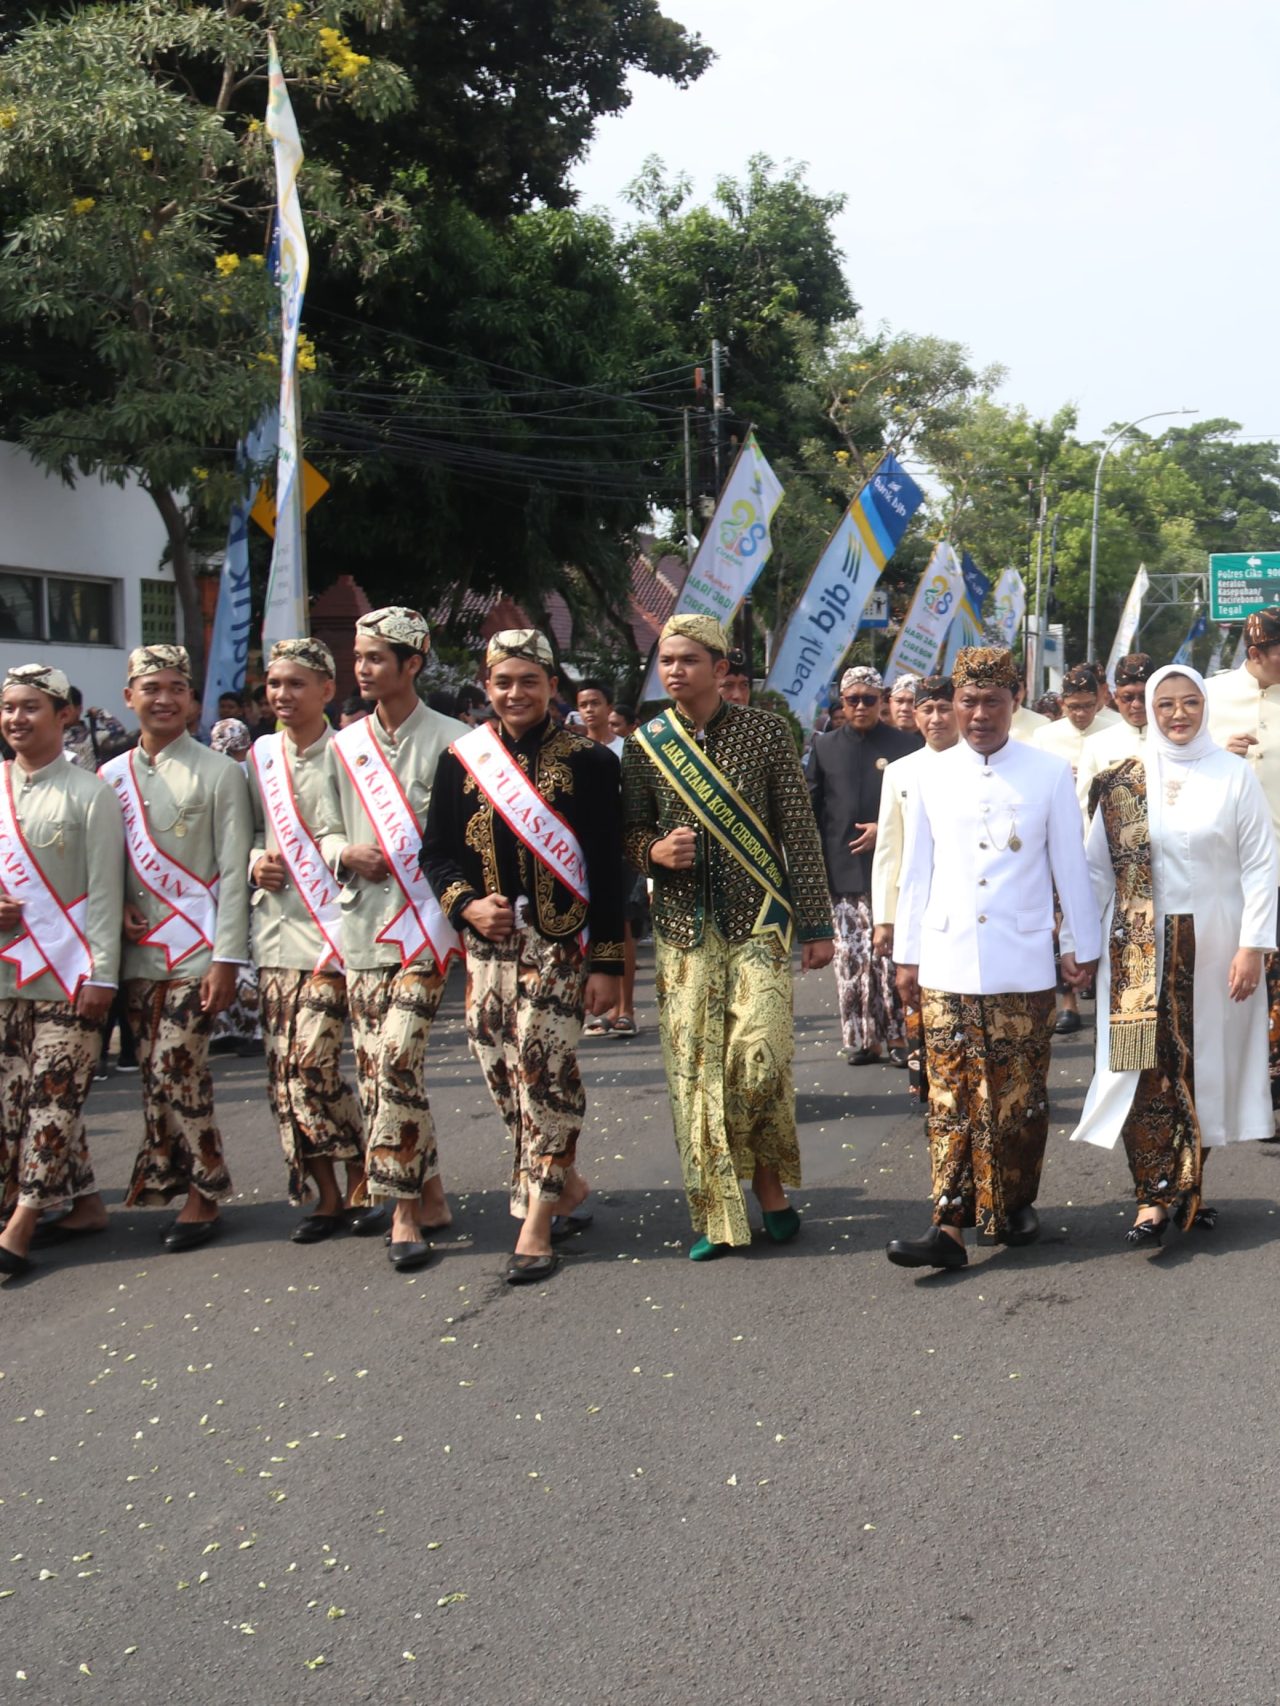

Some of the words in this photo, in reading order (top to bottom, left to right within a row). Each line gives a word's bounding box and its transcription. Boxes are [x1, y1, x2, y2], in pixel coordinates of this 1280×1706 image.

[808, 583, 851, 634] bjb
[1217, 569, 1244, 579] Polres
[1218, 580, 1247, 588] Keraton
[1218, 605, 1242, 616] Tegal
[114, 789, 191, 898] PEKALIPAN
[266, 776, 335, 908] PEKIRINGAN
[364, 769, 426, 884] KEJAKSAN
[490, 766, 586, 885] PULASAREN
[661, 739, 685, 770] JAKA
[680, 762, 713, 801] UTAMA
[707, 793, 734, 828] KOTA
[731, 817, 772, 868] CIREBON
